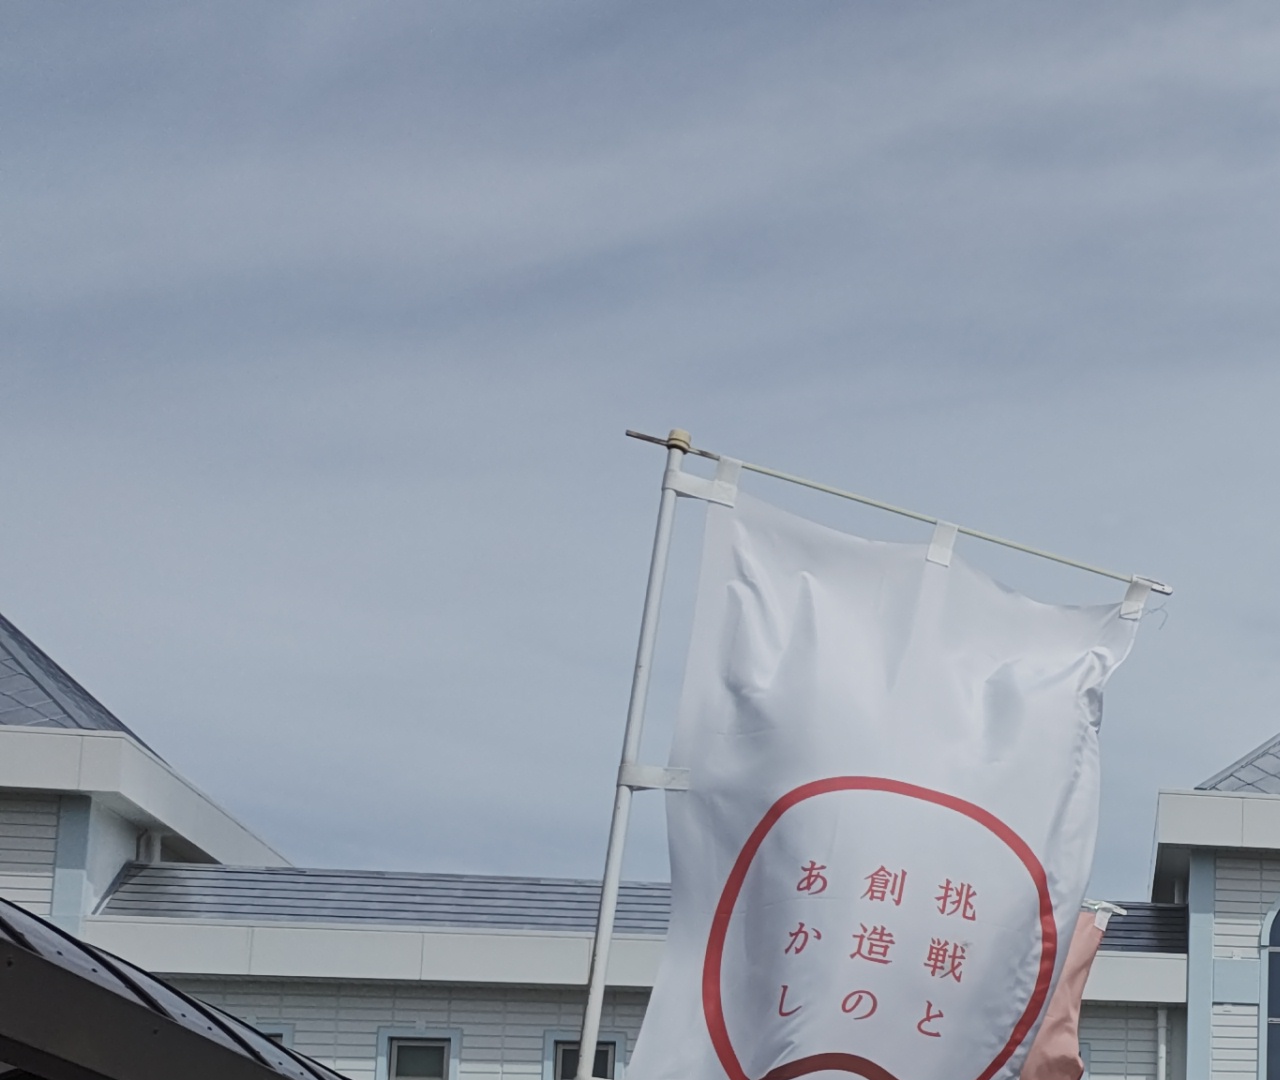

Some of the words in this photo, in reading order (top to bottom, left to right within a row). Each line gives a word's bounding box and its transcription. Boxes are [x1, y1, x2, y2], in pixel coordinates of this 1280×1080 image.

[777, 859, 828, 1018] あかし
[840, 864, 908, 1022] 創造の
[915, 876, 979, 1039] 挑戦と
